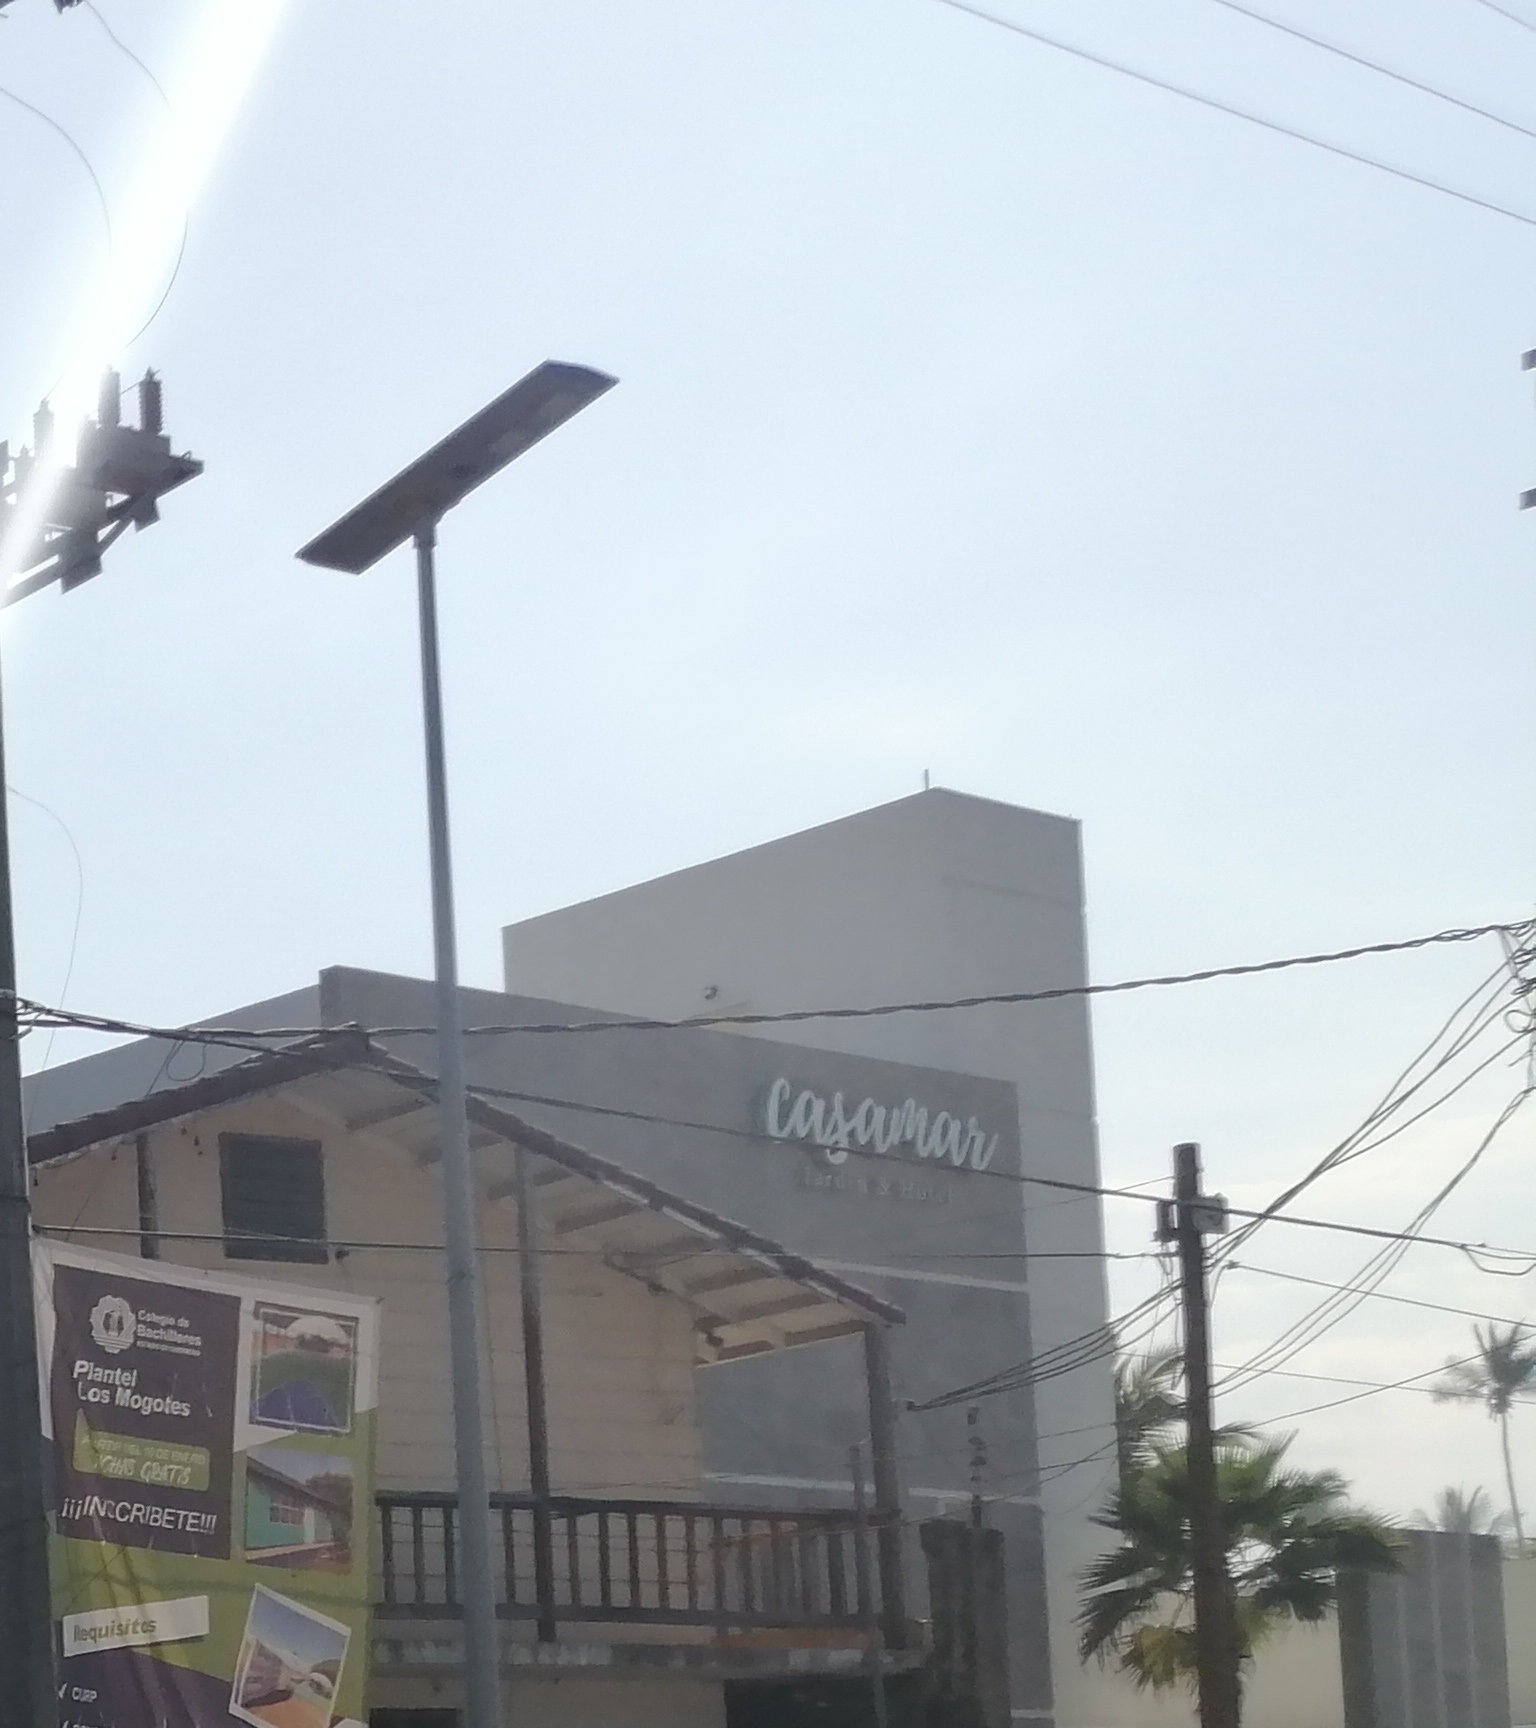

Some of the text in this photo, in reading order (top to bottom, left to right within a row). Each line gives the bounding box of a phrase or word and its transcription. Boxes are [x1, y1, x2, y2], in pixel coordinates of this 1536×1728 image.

[137, 1323, 202, 1346] Bachilleres
[73, 1359, 138, 1387] Plantel
[77, 1381, 192, 1417] Los Mogotes
